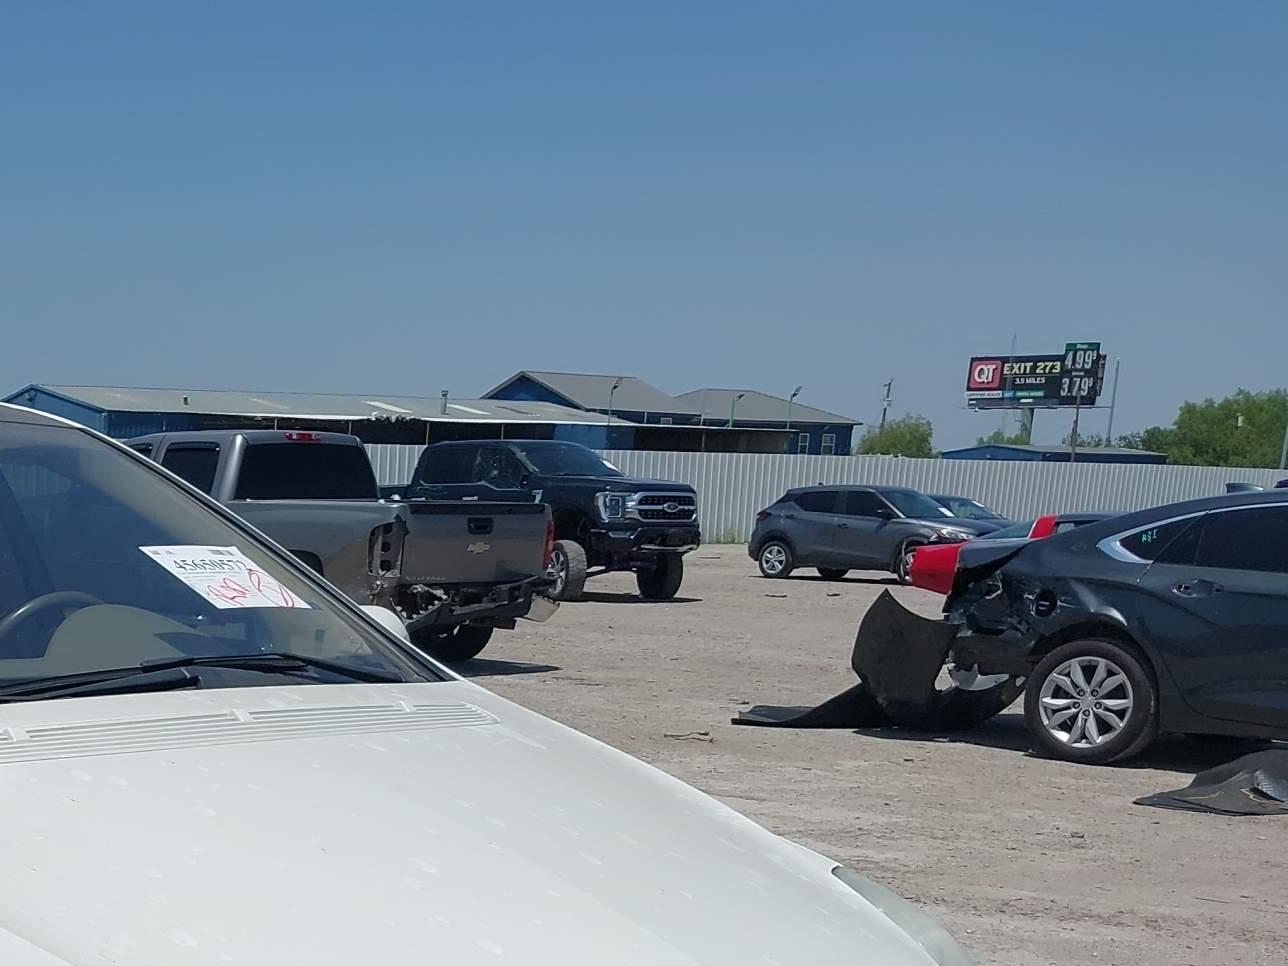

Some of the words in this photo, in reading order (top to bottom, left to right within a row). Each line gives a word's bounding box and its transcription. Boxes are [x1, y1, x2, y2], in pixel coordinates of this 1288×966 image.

[974, 364, 997, 384] QT
[1004, 362, 1034, 375] EXIT
[1036, 361, 1061, 374] 273
[1025, 376, 1046, 384] MILES
[172, 559, 248, 571] 45650572
